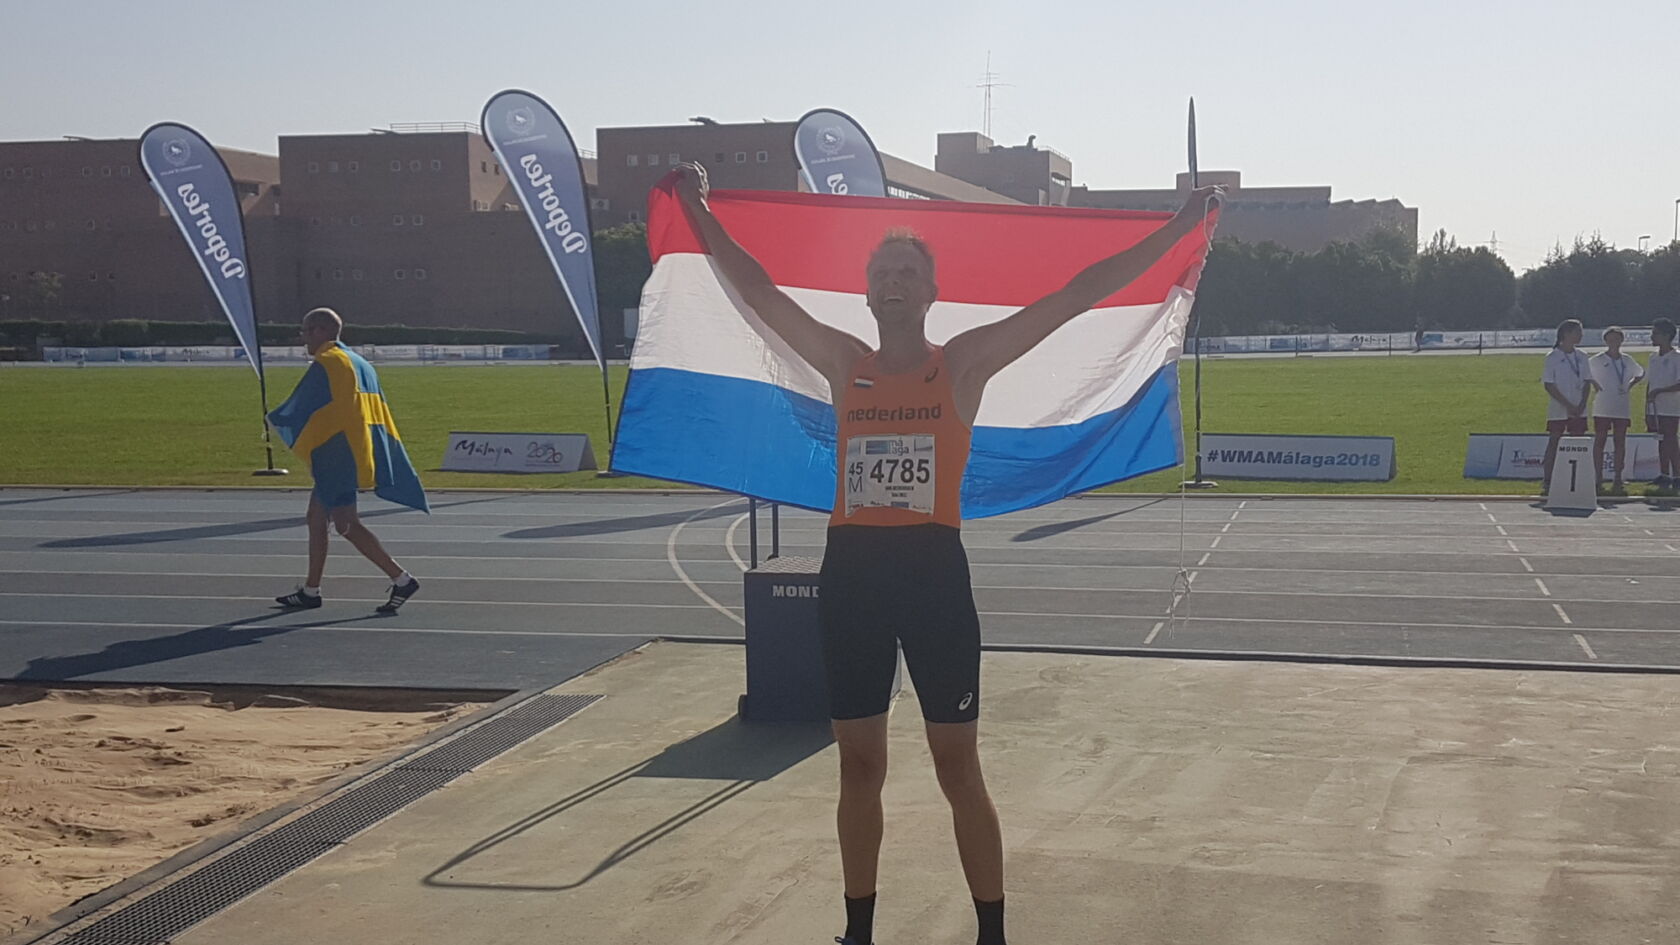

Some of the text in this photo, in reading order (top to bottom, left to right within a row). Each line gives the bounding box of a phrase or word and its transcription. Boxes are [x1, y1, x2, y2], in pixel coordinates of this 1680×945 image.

[847, 403, 942, 422] nederland
[1207, 449, 1381, 468] #WMAMálaga2018
[848, 461, 864, 476] 45
[870, 458, 930, 484] 4785
[1568, 459, 1578, 492] 1
[848, 476, 863, 493] M
[772, 585, 820, 598] MOND
